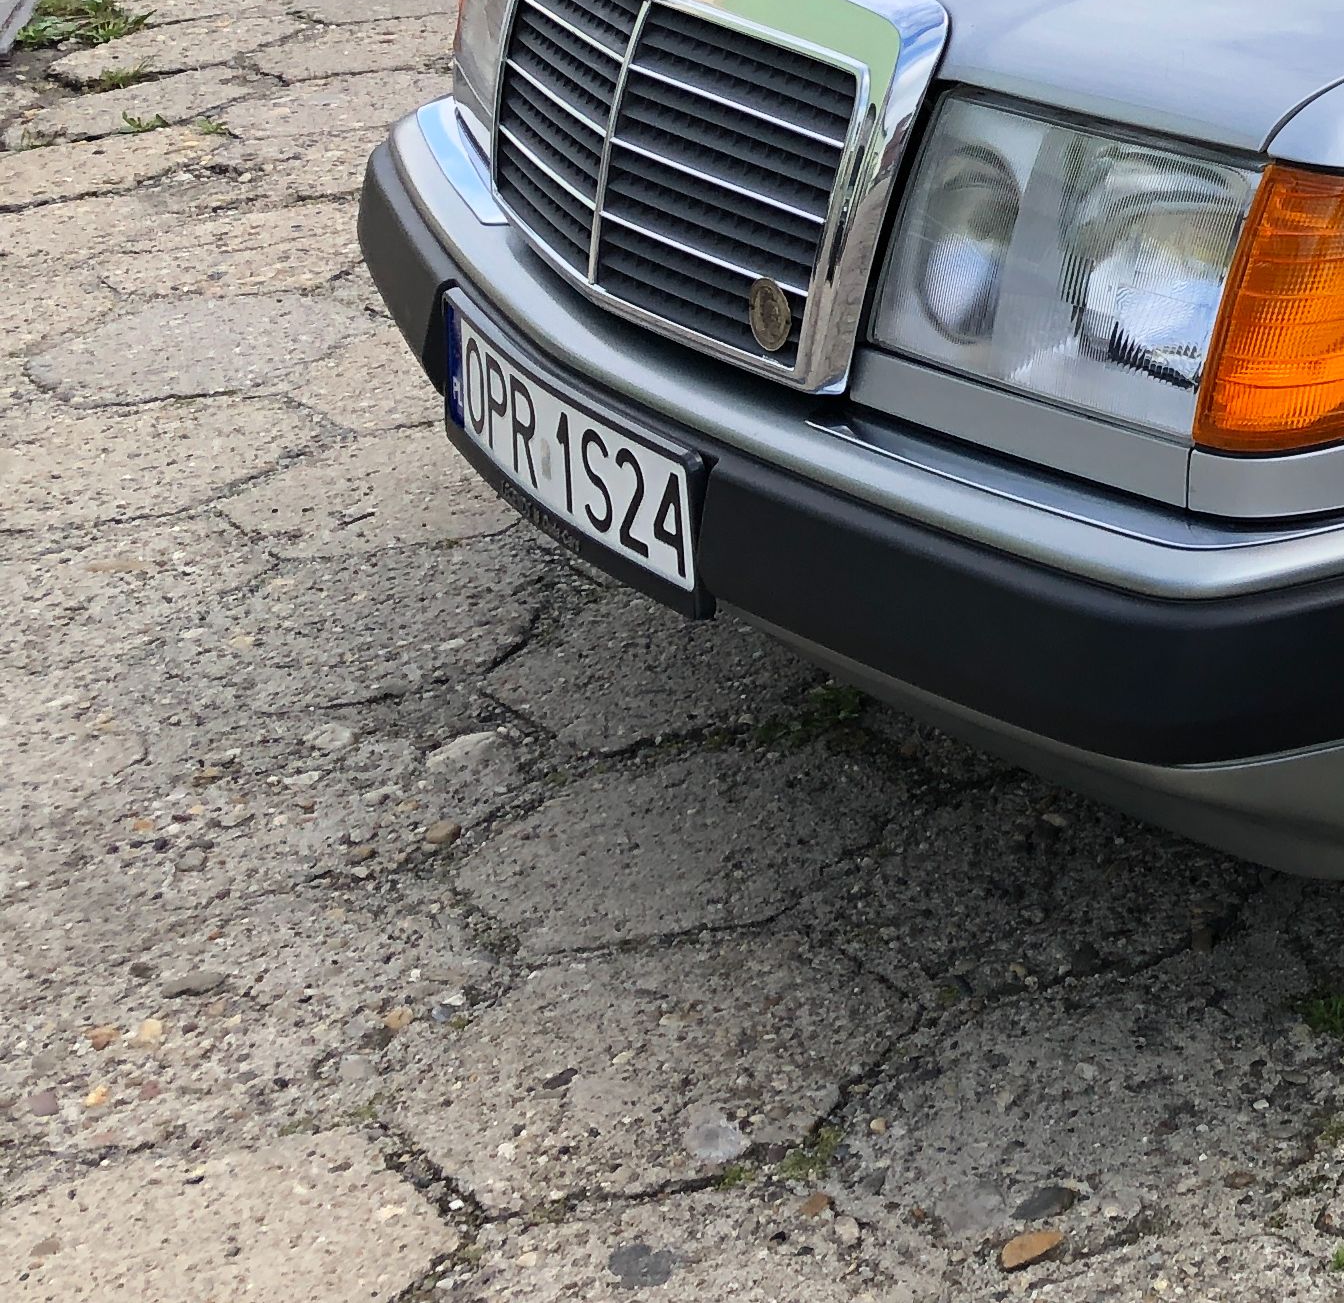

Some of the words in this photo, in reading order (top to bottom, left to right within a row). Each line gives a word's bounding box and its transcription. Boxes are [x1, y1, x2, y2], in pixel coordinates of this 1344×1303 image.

[452, 375, 464, 408] PL
[465, 336, 539, 490] OPR
[555, 411, 687, 579] 1S24
